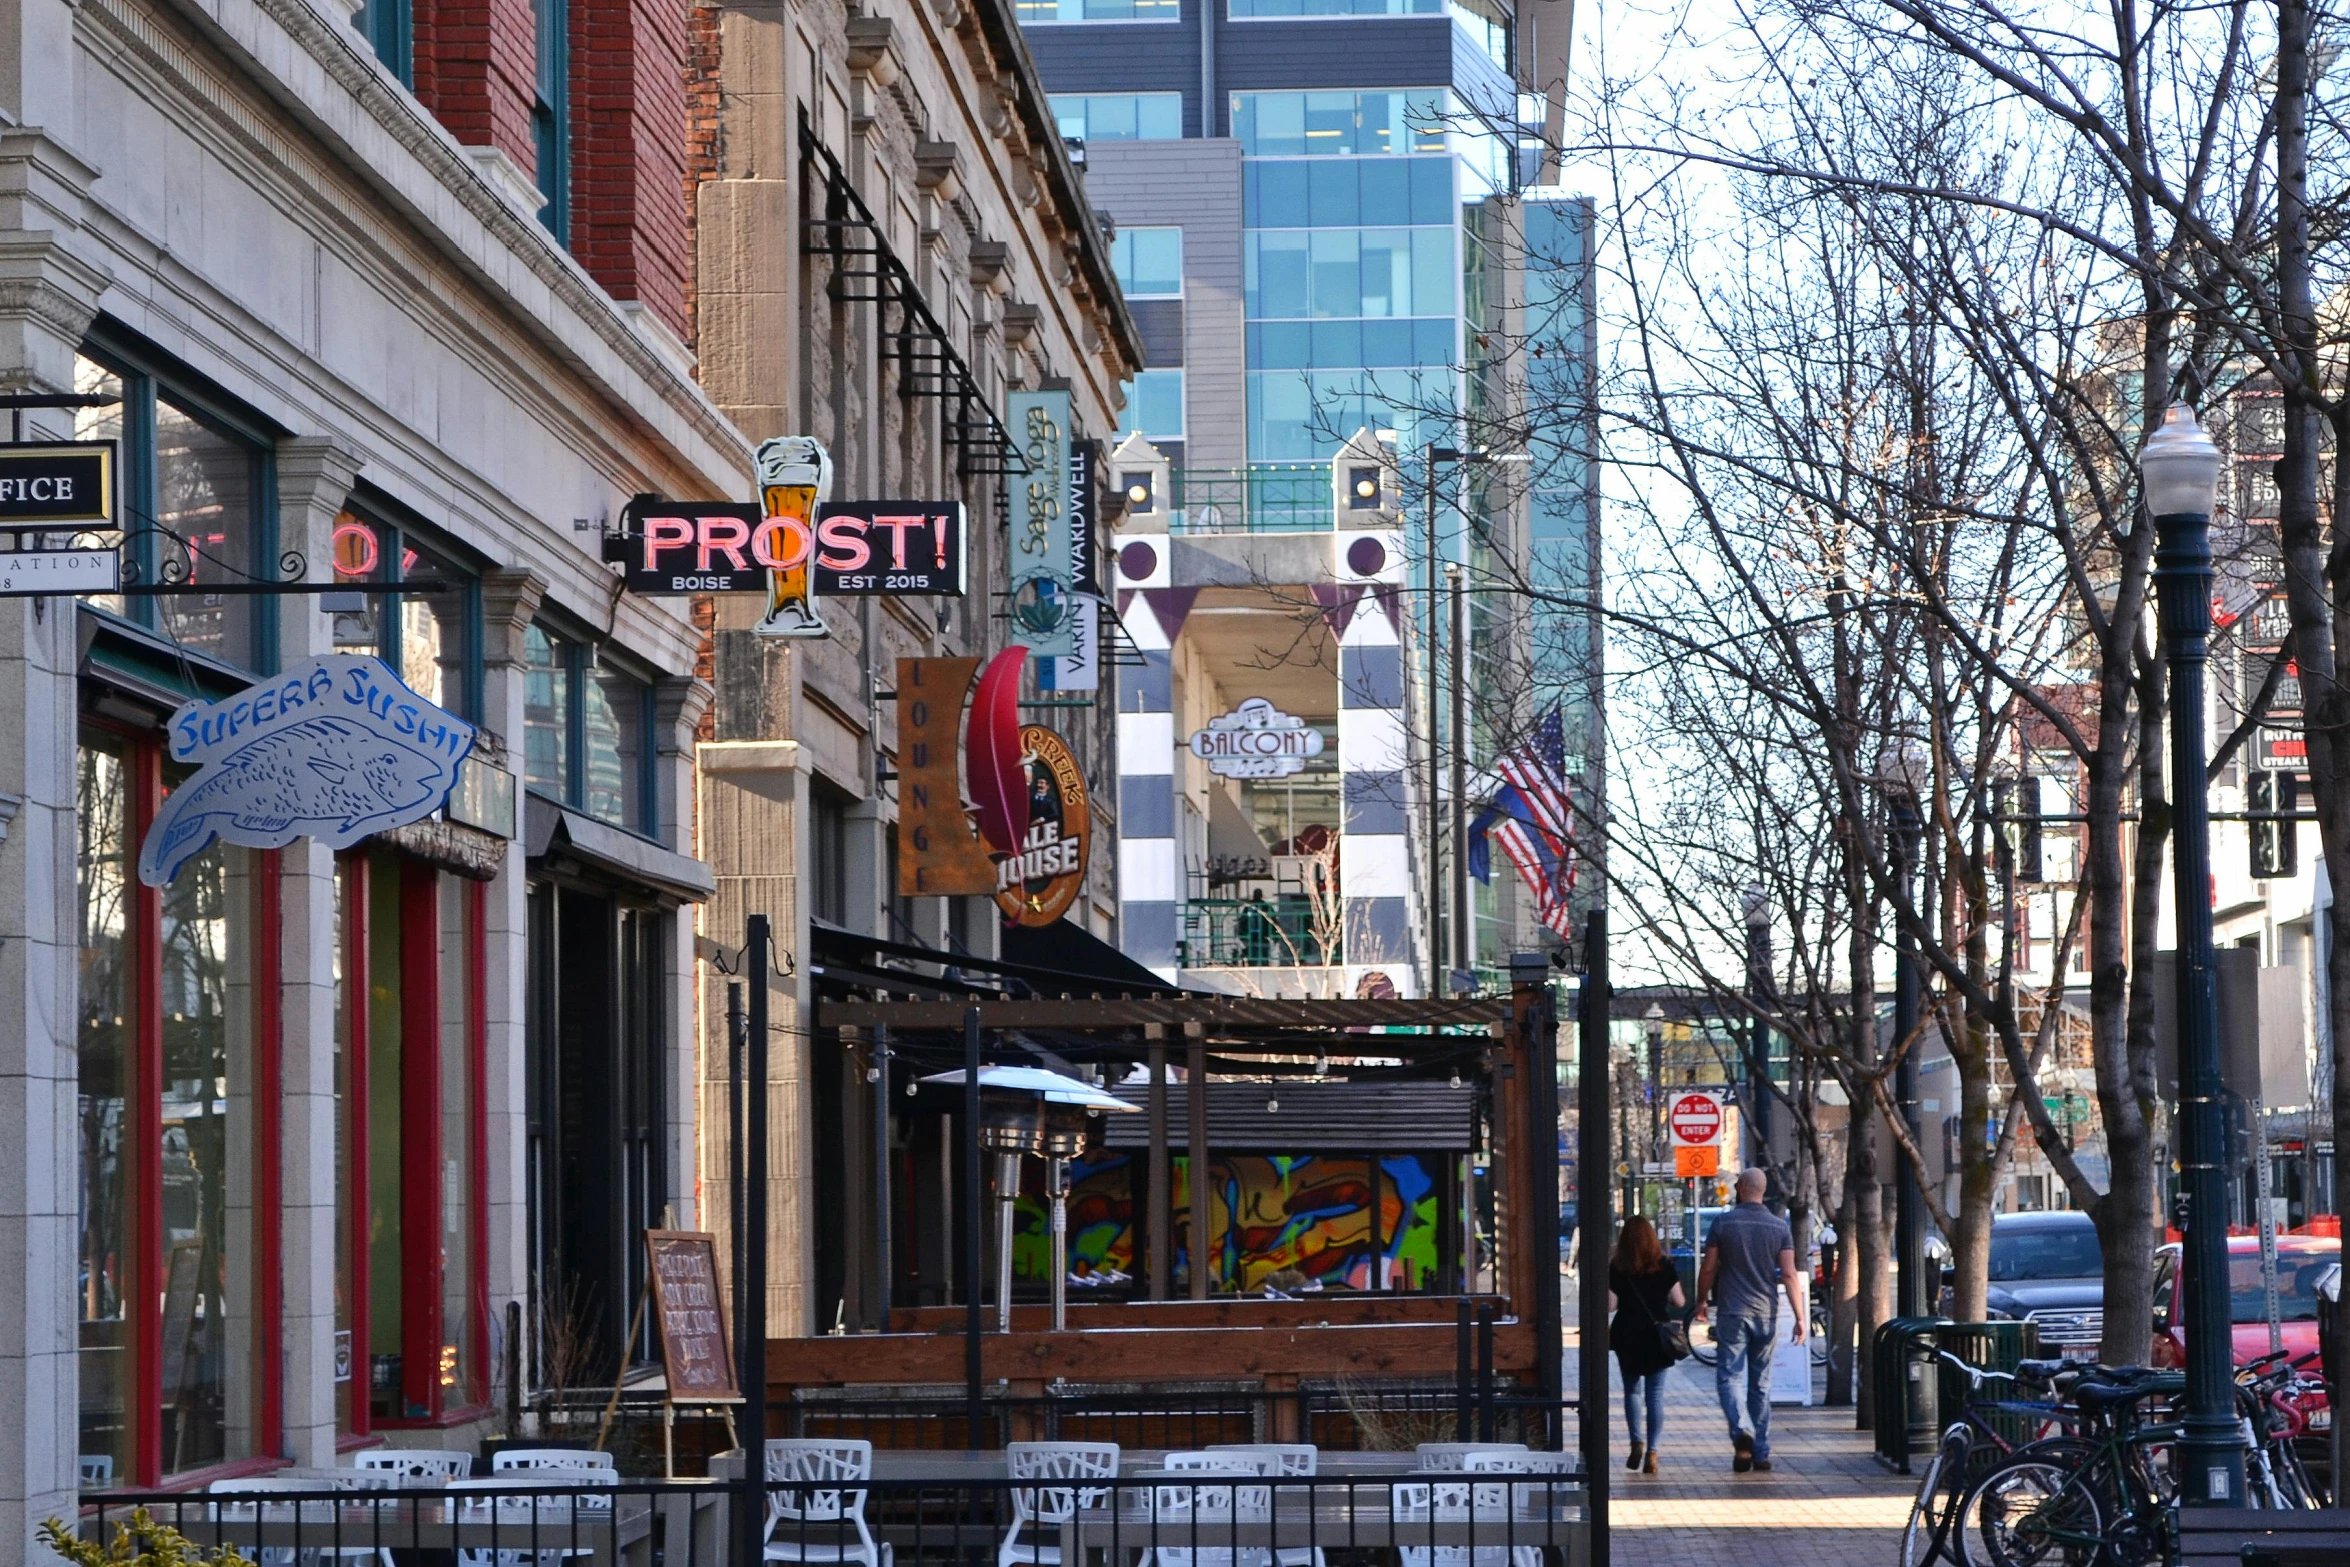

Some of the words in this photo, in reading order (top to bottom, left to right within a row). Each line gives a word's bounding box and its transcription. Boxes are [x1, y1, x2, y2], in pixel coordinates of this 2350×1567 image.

[0, 477, 73, 501] FICE
[1020, 482, 1060, 558] Sage
[1070, 452, 1086, 584] WARDWELL
[641, 515, 950, 572] PROST!
[672, 577, 732, 590] BOISE
[838, 575, 876, 589] EST
[885, 575, 930, 589] 2015
[177, 667, 333, 756] SUPERB
[343, 668, 459, 757] SUSHI
[1201, 732, 1311, 754] BALCONY
[911, 660, 929, 892] LOUNGE
[1020, 728, 1085, 806] CREEK
[1677, 1103, 1691, 1113] DO
[1695, 1103, 1713, 1113] NOT
[1681, 1126, 1711, 1135] ENTER
